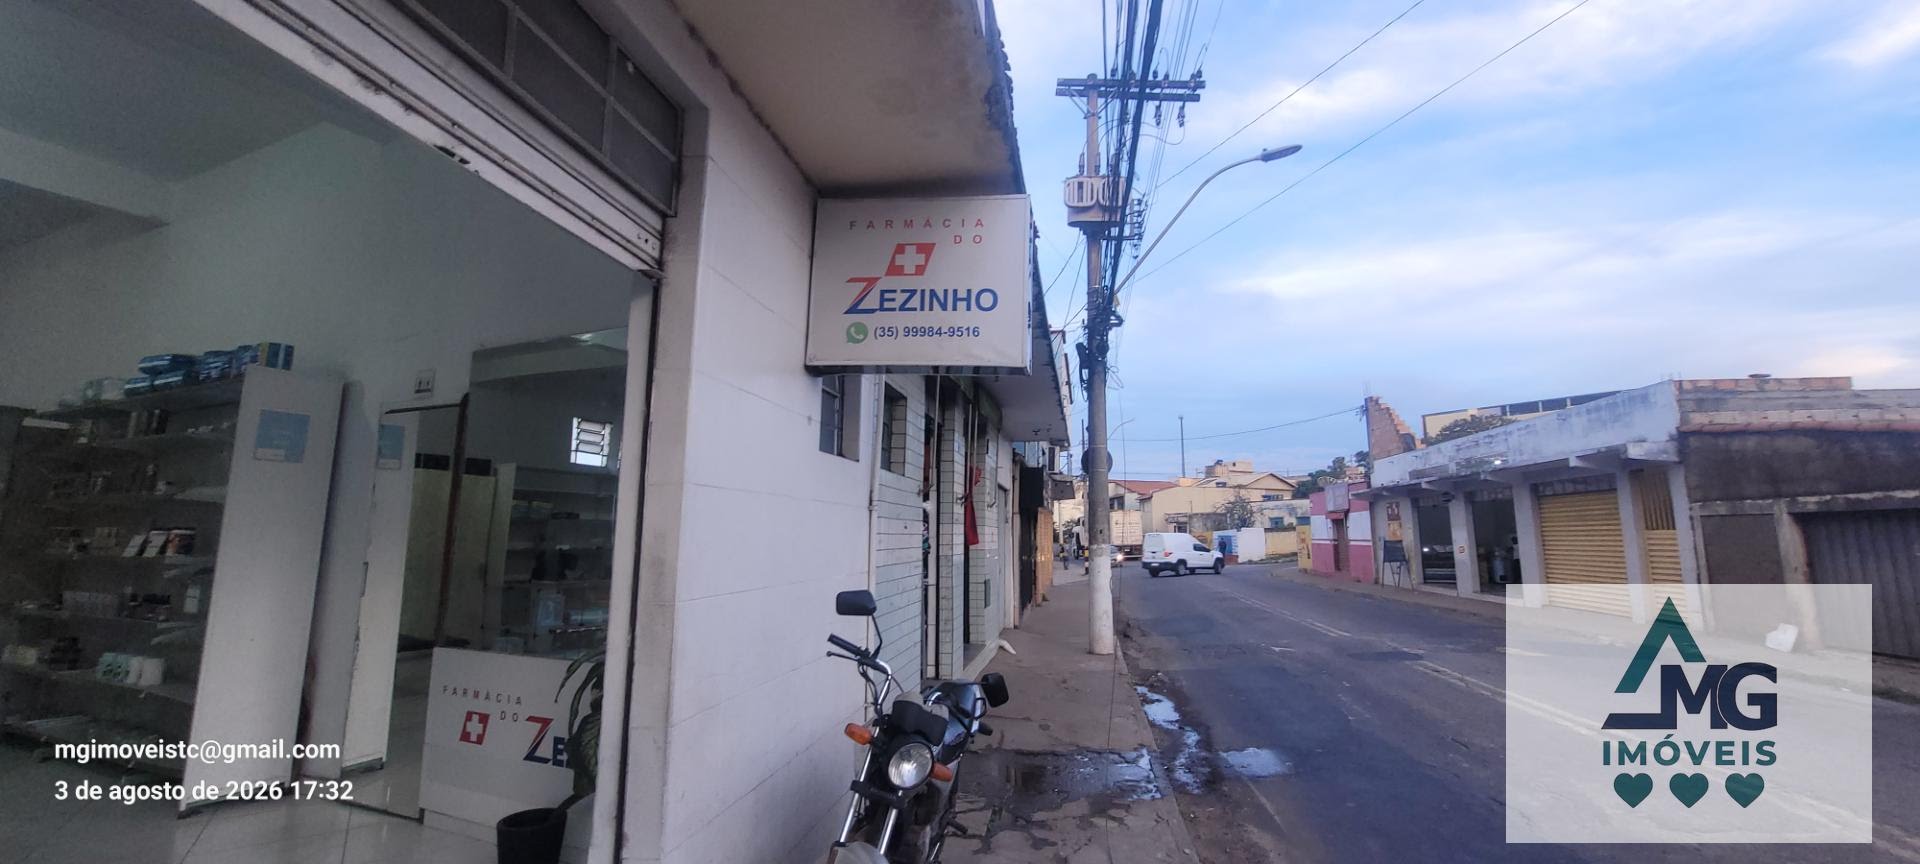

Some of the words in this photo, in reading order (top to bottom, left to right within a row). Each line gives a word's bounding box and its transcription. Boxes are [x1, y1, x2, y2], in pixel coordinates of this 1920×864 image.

[850, 218, 985, 231] FARMÁCIA
[953, 234, 983, 245] DO
[843, 276, 999, 315] ZEZINHO
[873, 326, 899, 340] (35)
[903, 326, 981, 338] 99984-9516
[500, 710, 519, 722] DO
